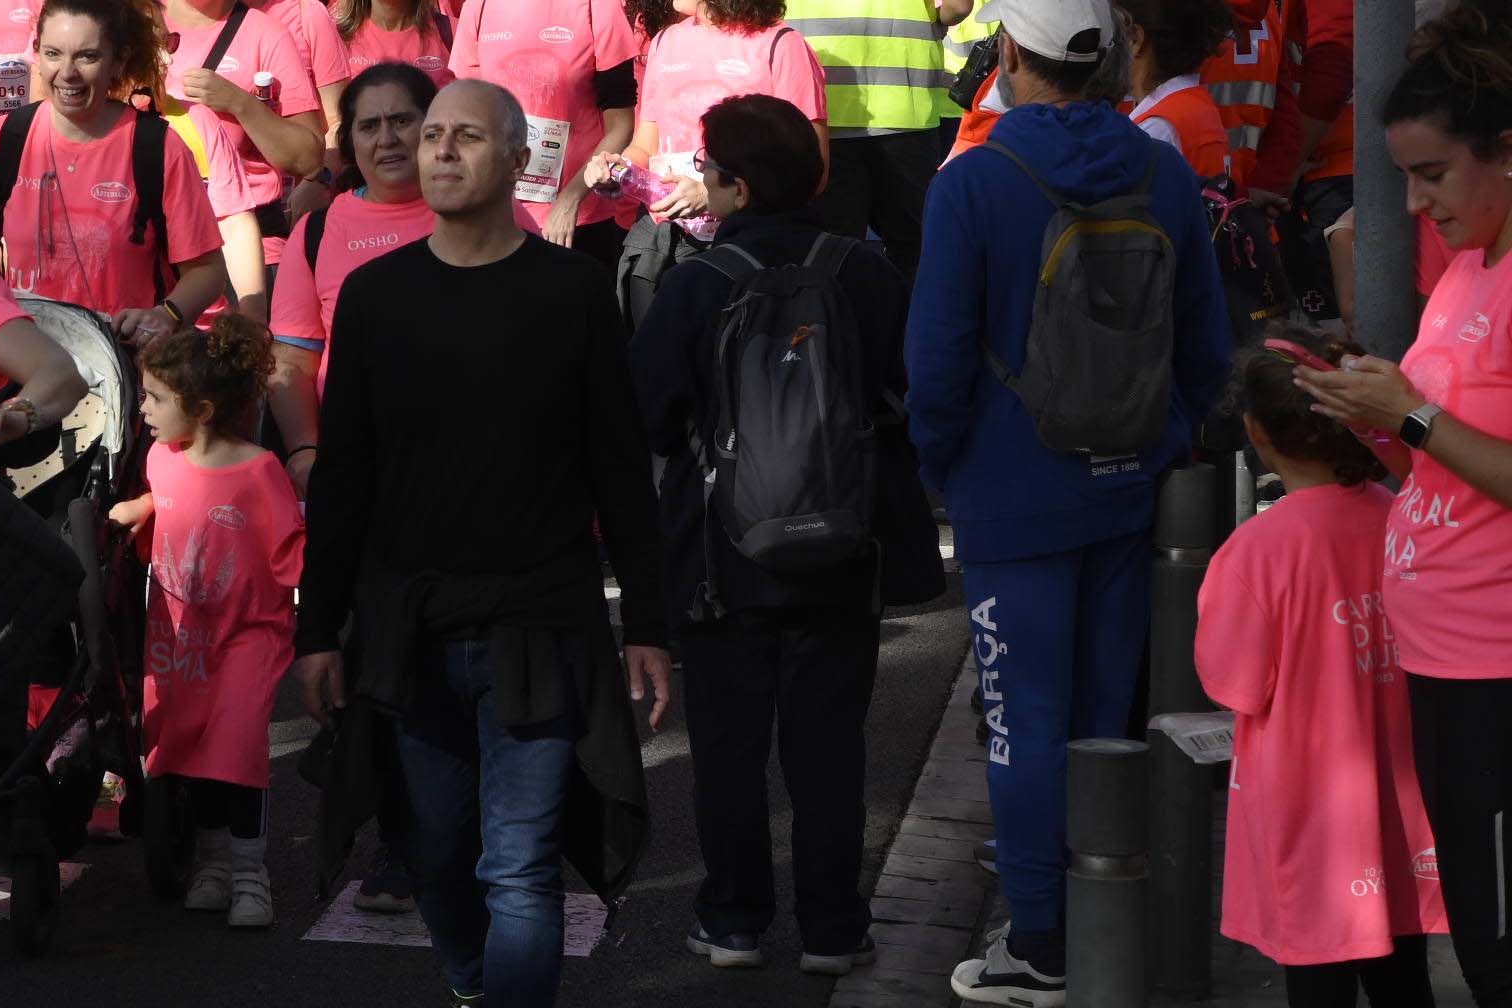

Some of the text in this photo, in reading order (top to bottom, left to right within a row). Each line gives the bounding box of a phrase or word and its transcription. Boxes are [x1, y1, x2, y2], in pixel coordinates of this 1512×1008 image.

[347, 232, 399, 251] OYSHO
[1091, 461, 1139, 477] SINCE 1899
[784, 519, 826, 533] Quechua
[1332, 591, 1384, 625] CARR
[971, 595, 1010, 766] BARÇA
[1350, 879, 1382, 897] OY
